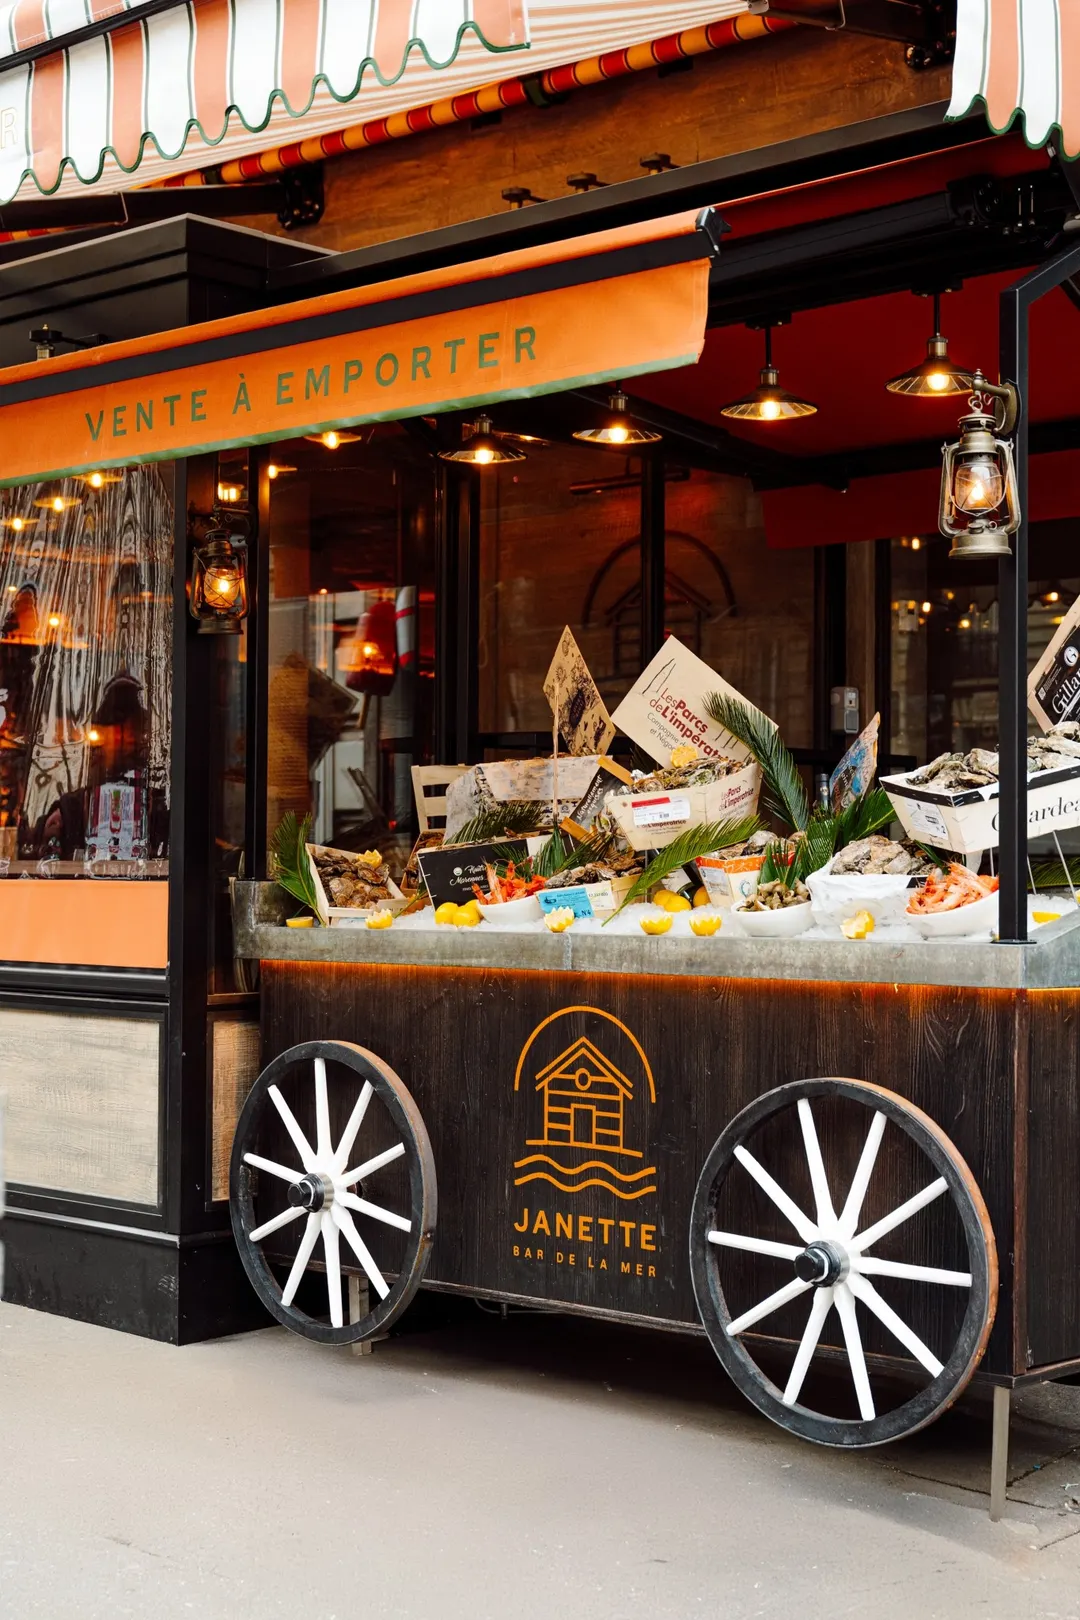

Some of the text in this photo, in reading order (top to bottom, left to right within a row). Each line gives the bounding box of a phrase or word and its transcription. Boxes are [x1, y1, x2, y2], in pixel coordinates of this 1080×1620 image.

[84, 325, 537, 442] VENTE À EMPORTER
[513, 1208, 657, 1251] JANETTE
[513, 1245, 657, 1277] BAR DE LA MER
